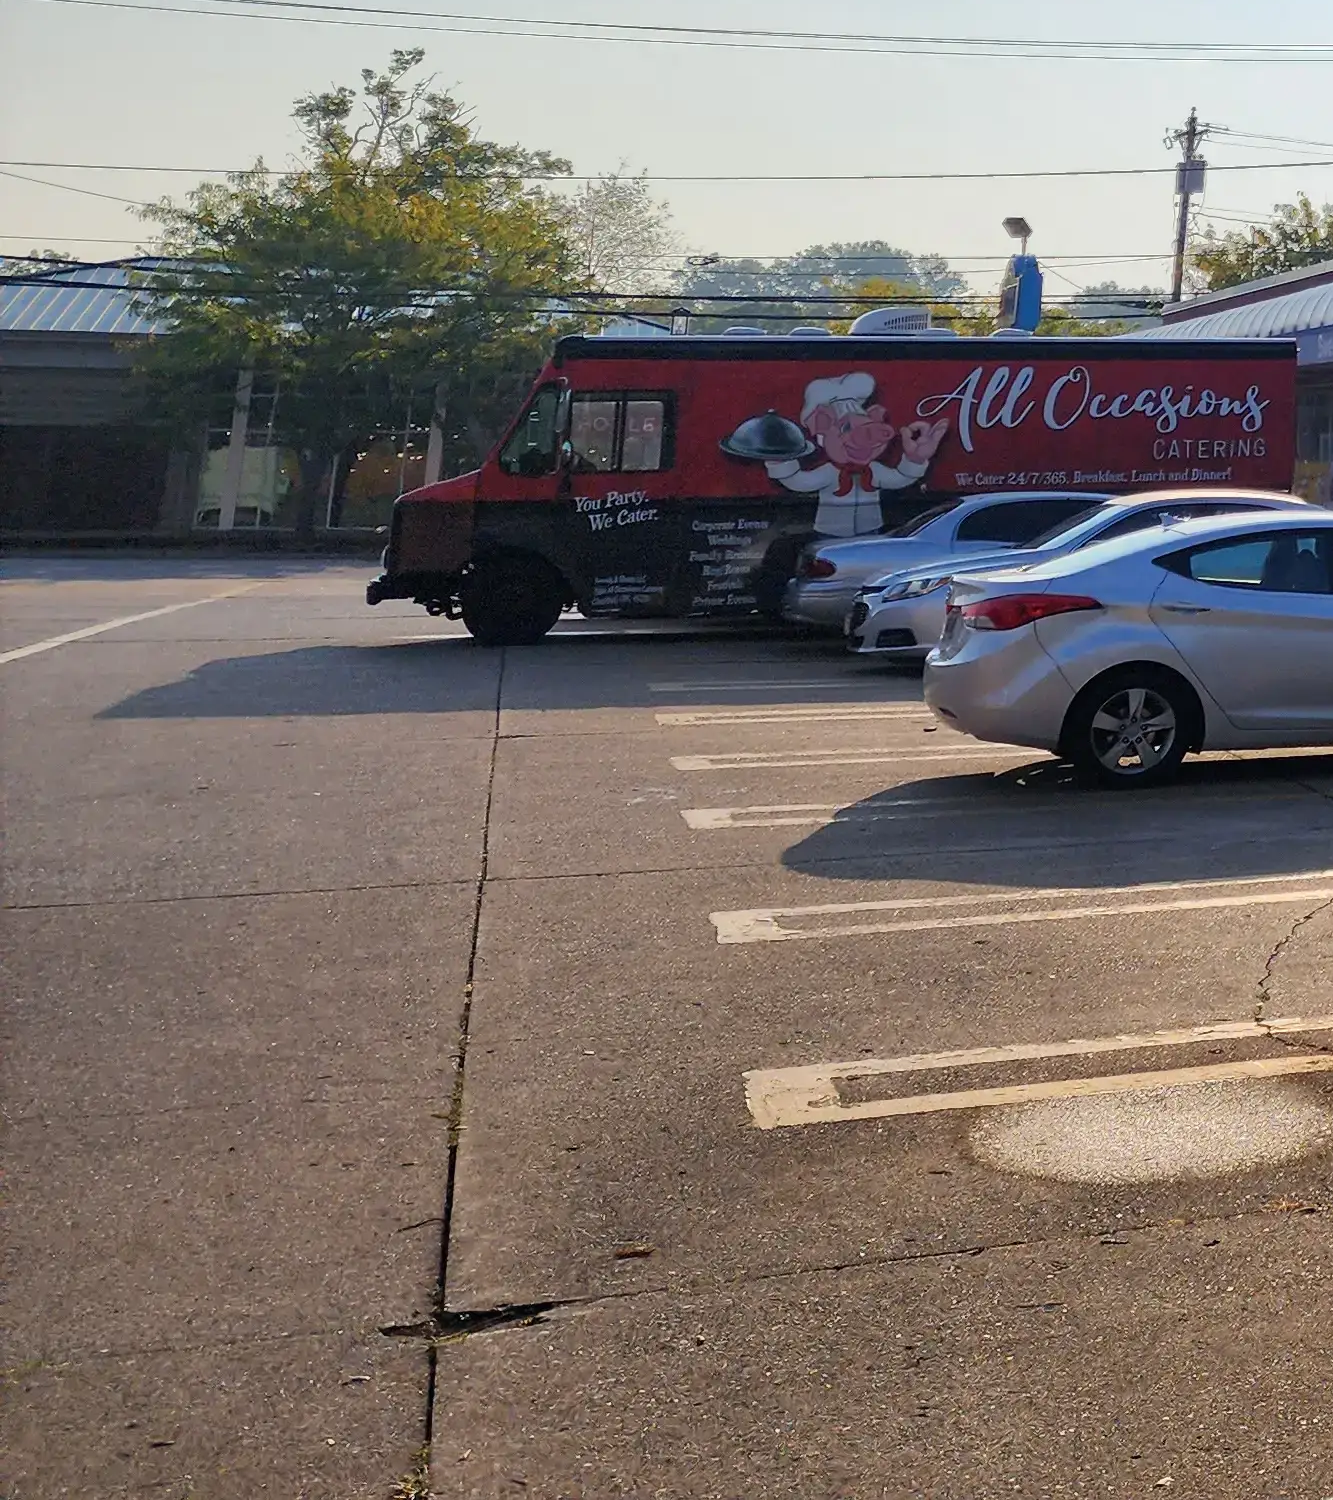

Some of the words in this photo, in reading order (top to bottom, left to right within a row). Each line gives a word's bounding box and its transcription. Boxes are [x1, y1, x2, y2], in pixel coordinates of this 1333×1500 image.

[917, 365, 1036, 453] All
[1042, 365, 1271, 434] Occasions
[1152, 437, 1267, 461] CATERING
[955, 472, 974, 487] We
[975, 472, 1004, 486] Cater
[1130, 469, 1166, 483] Lunch
[1168, 468, 1189, 482] and
[1190, 467, 1232, 482] Dinner!
[574, 496, 601, 513] You
[604, 489, 649, 509] Party.
[588, 513, 613, 532] We
[616, 507, 660, 527] Cater.
